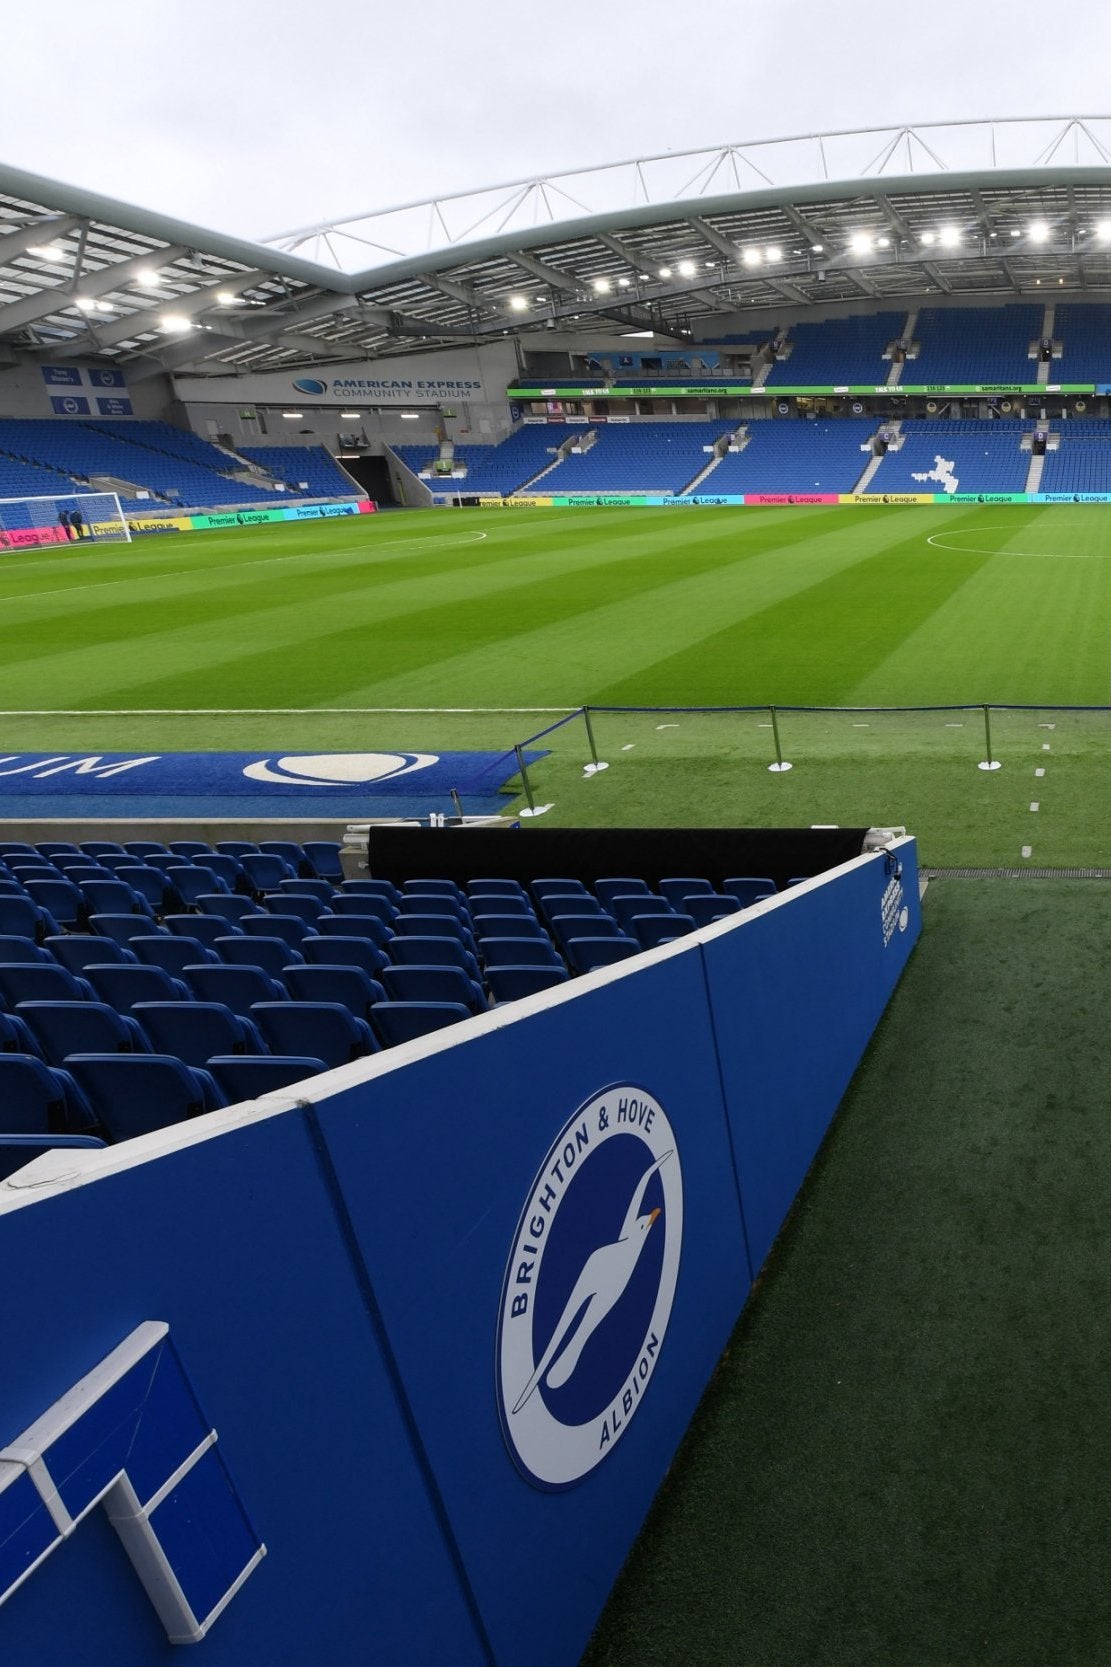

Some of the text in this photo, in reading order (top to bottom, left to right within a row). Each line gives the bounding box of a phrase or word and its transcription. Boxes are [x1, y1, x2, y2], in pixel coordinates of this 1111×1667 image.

[333, 379, 481, 389] AMERICAN EXPRESS
[333, 389, 471, 398] COMMUNITY STADIUM
[568, 498, 595, 506] Premier
[949, 495, 1012, 503] Premier League
[1045, 494, 1108, 502] Premier League
[297, 506, 319, 517] Premier
[208, 513, 269, 525] Premier League
[510, 1098, 657, 1319] BRIGHTON & HOVE
[600, 1332, 659, 1450] ALBION
